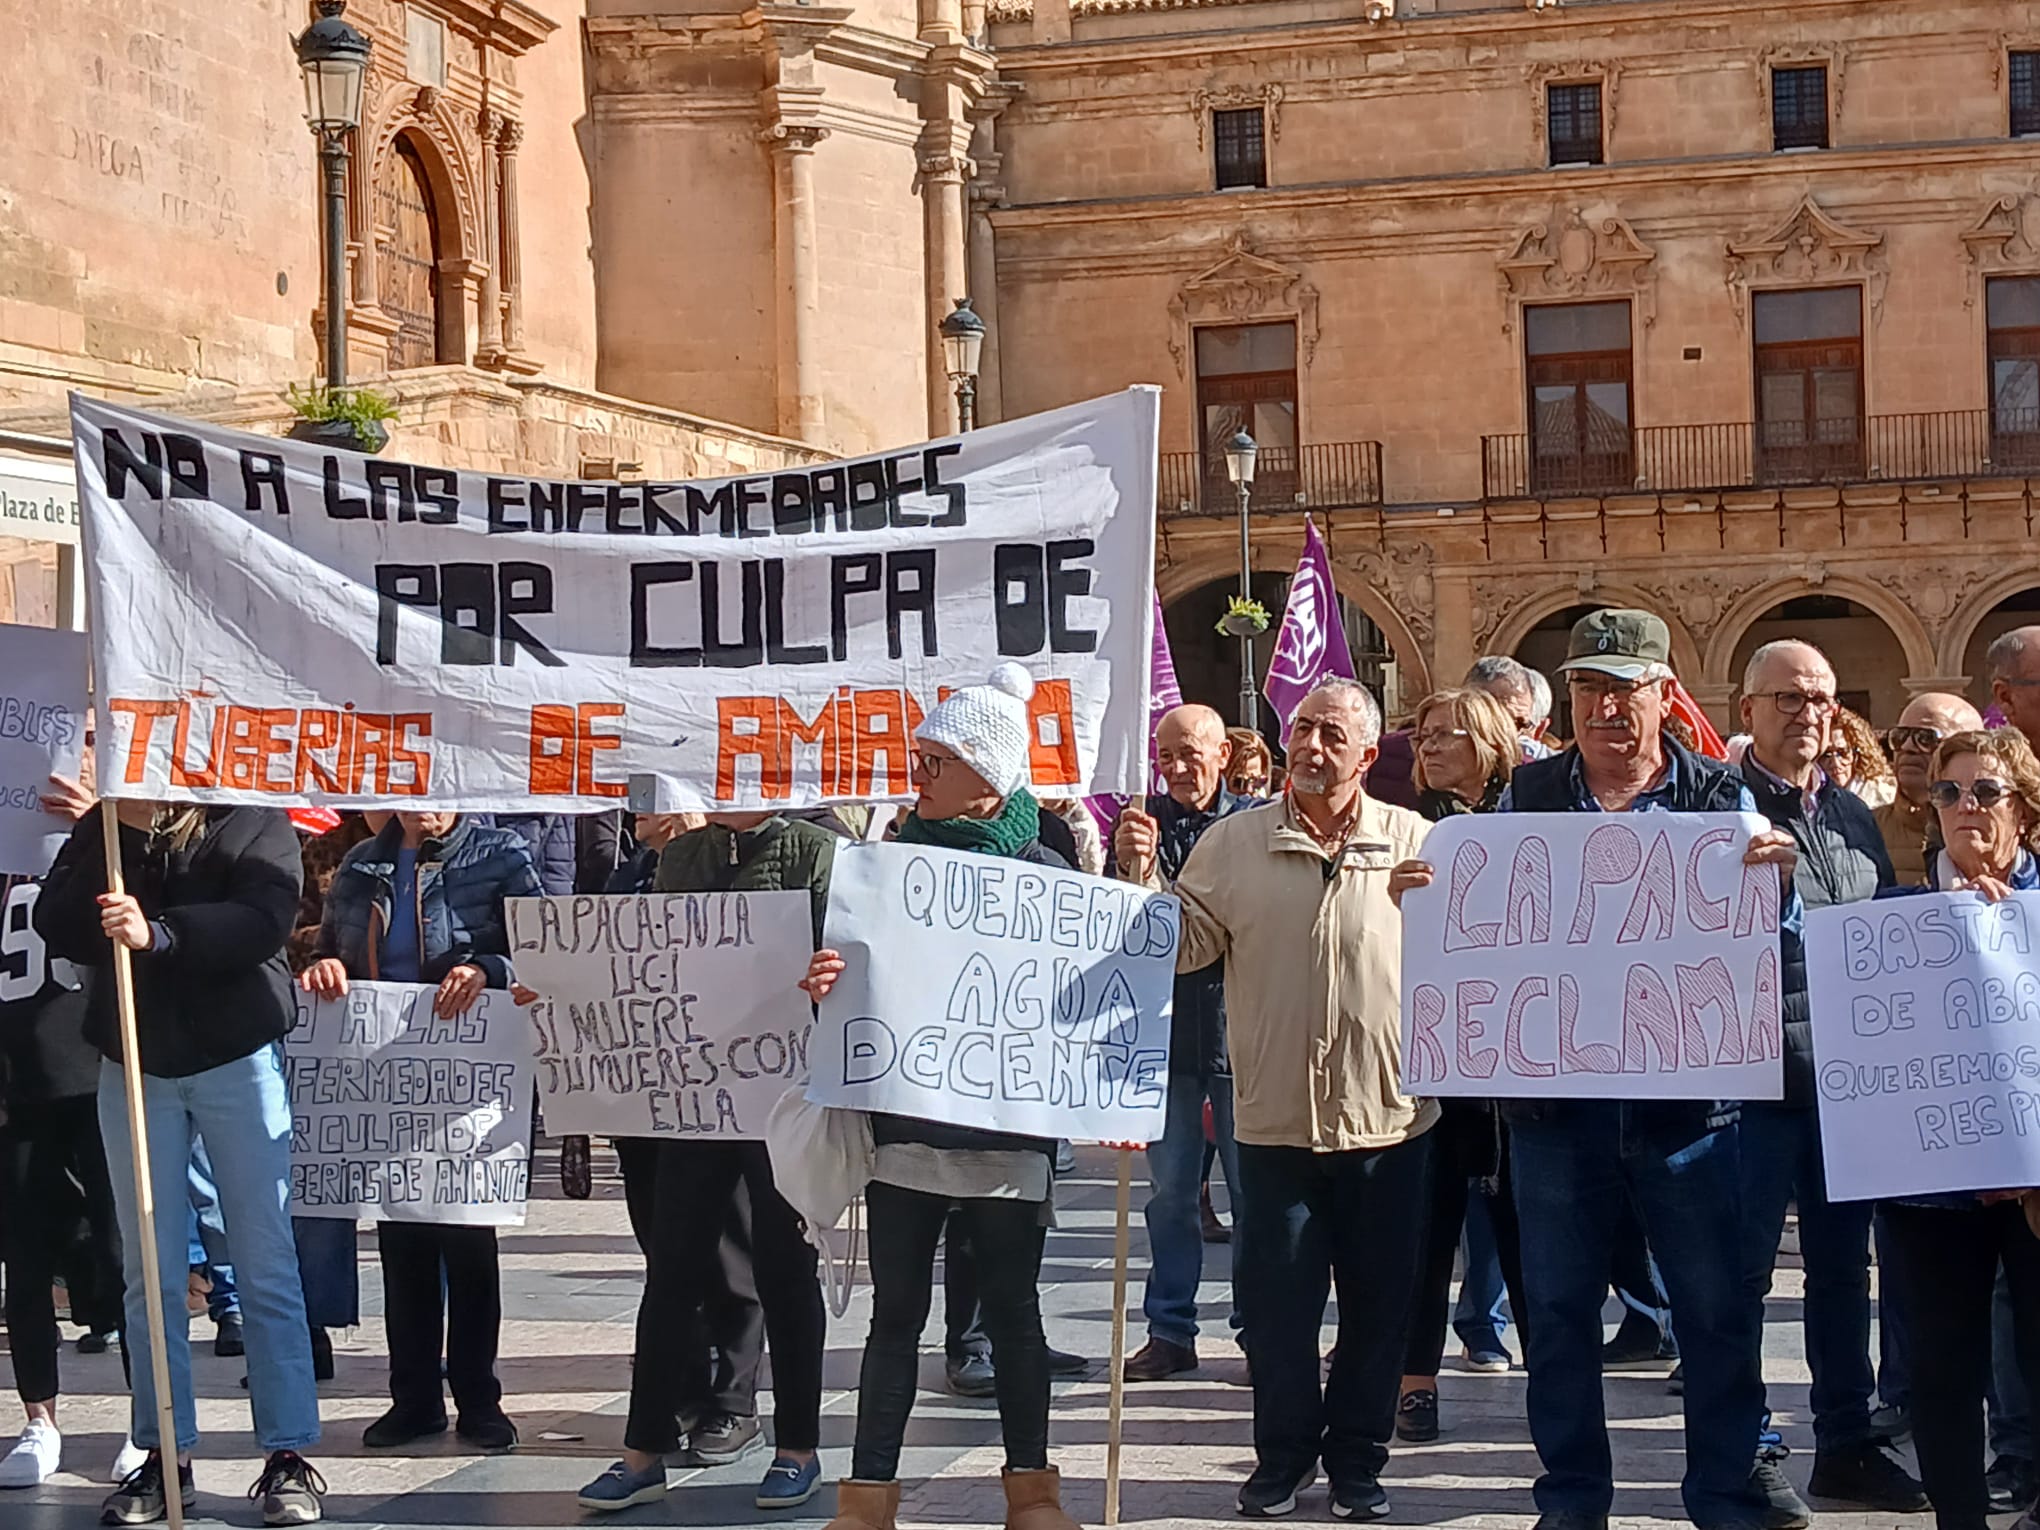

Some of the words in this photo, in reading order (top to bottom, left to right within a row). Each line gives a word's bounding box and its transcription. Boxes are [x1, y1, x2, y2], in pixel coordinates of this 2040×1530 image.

[0, 491, 39, 521] laza
[44, 497, 65, 524] de
[103, 428, 209, 501] NO
[239, 449, 290, 515] A
[323, 455, 459, 524] LAS
[487, 444, 967, 538] ENFERMEDADES
[375, 561, 568, 668] POR
[629, 548, 938, 668] CULPA
[994, 538, 1098, 656] DE
[0, 697, 76, 746] BLES
[529, 702, 630, 797] DE
[715, 678, 1081, 800] AMIAO
[904, 856, 1175, 958] QUEREMOS
[1443, 838, 1551, 953] LA
[1567, 823, 1780, 944] PACA
[1843, 900, 2030, 981] BASTA
[340, 988, 379, 1044] A
[392, 990, 490, 1044] LAS
[530, 996, 561, 1057] SI
[568, 994, 707, 1054] MUERE
[947, 952, 1140, 1047] AGUA
[1408, 946, 1780, 1084] RECLAMA
[1852, 992, 1915, 1037] DE
[1944, 971, 2040, 1030] ABA
[286, 1057, 515, 1112] FERMEDADES
[842, 1016, 1167, 1110] DECENTE
[1819, 1045, 2040, 1102] QUEREMOS
[319, 1112, 435, 1153] CULPA
[446, 1112, 494, 1153] DE
[649, 1088, 744, 1134] ELLA
[290, 1157, 381, 1206] BERIAS
[388, 1159, 423, 1203] DE
